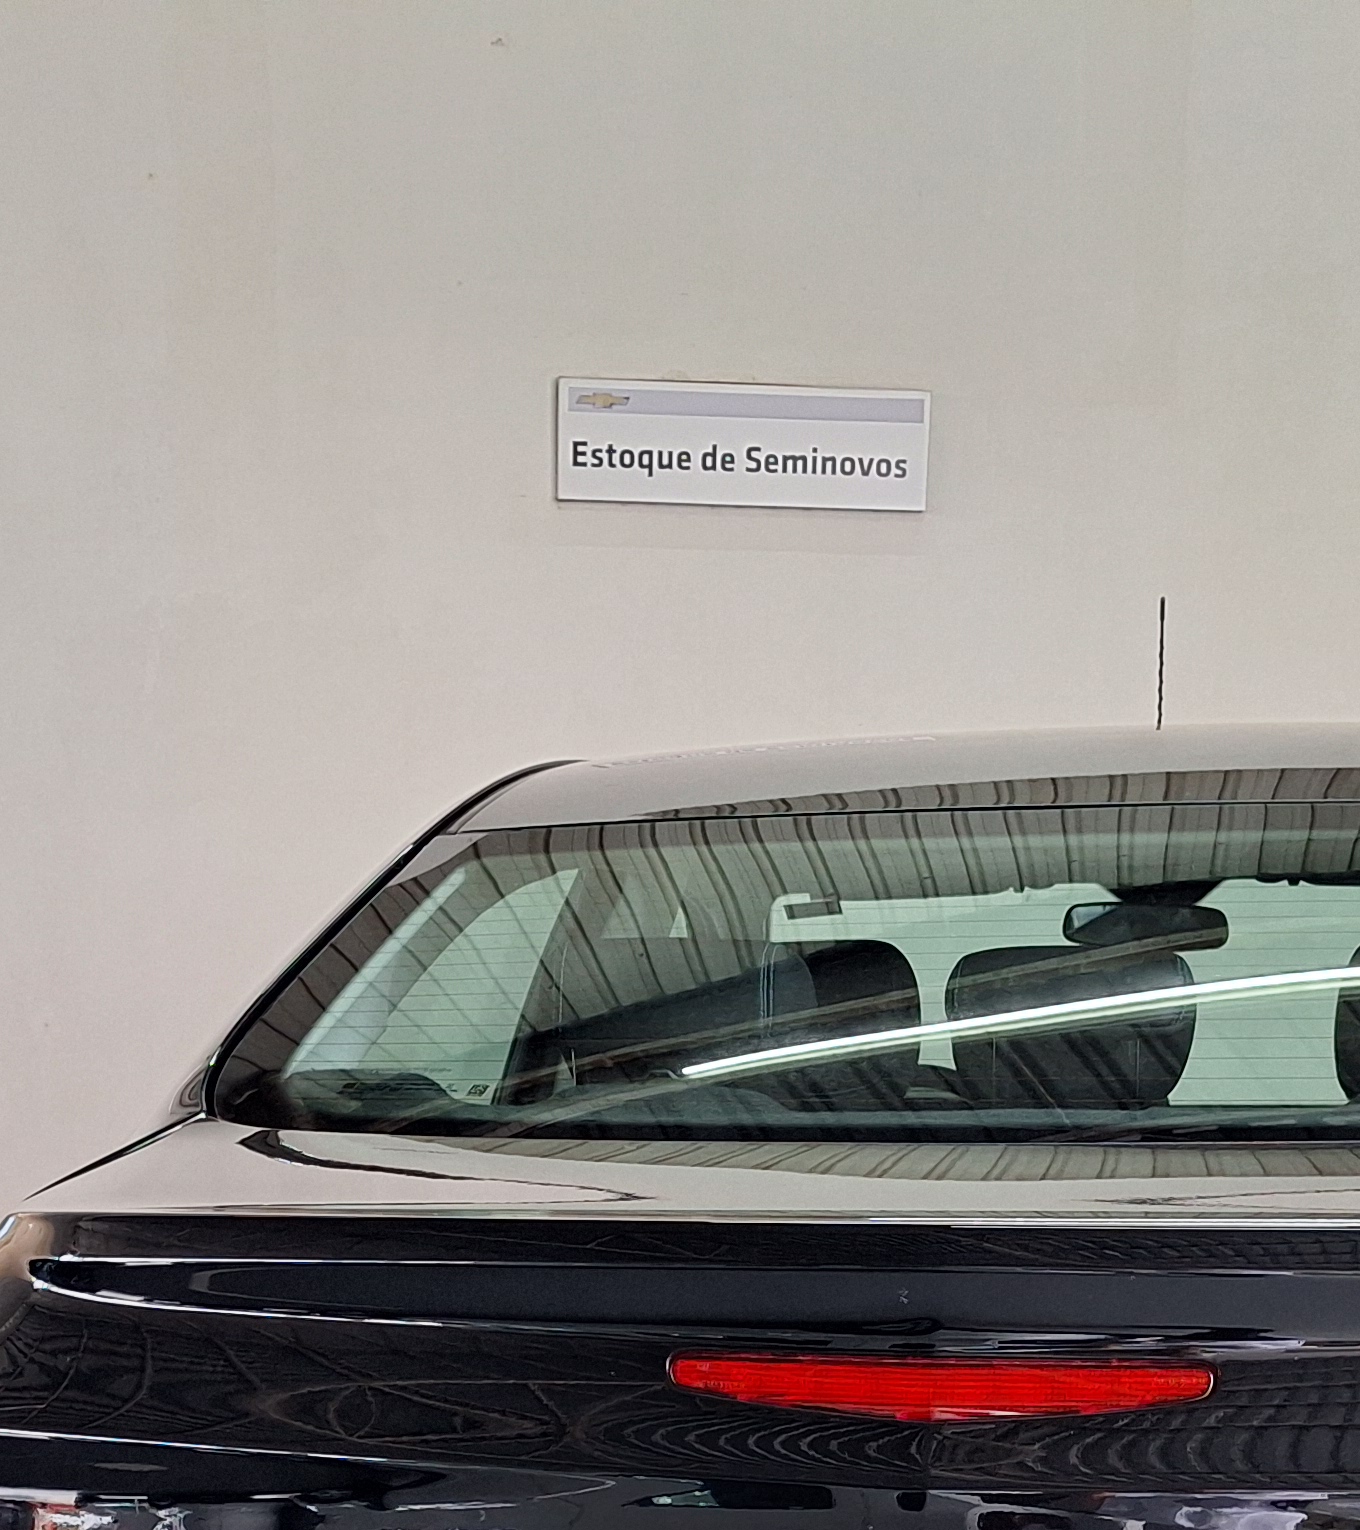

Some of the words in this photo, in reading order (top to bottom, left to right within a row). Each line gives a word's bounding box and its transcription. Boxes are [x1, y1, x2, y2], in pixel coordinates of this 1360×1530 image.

[571, 440, 692, 478] Estoque
[700, 443, 736, 473] de
[744, 446, 909, 479] Seminovos
